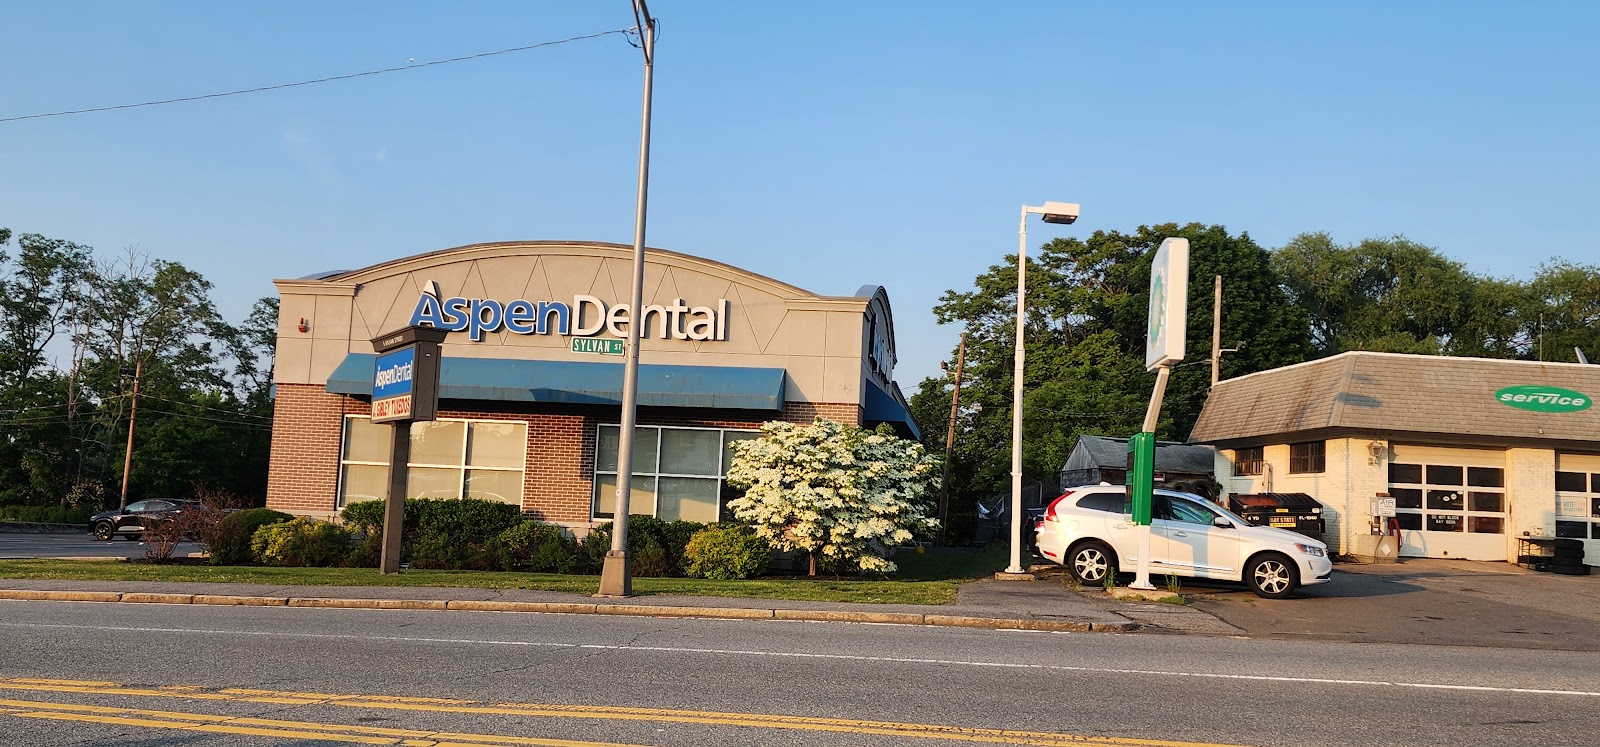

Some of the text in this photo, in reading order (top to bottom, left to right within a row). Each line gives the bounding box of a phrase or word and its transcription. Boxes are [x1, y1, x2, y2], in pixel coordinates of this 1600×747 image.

[408, 279, 726, 341] AspenDental
[573, 339, 622, 352] SYLVAN ST
[375, 360, 412, 389] AspenDental
[1500, 392, 1585, 406] service
